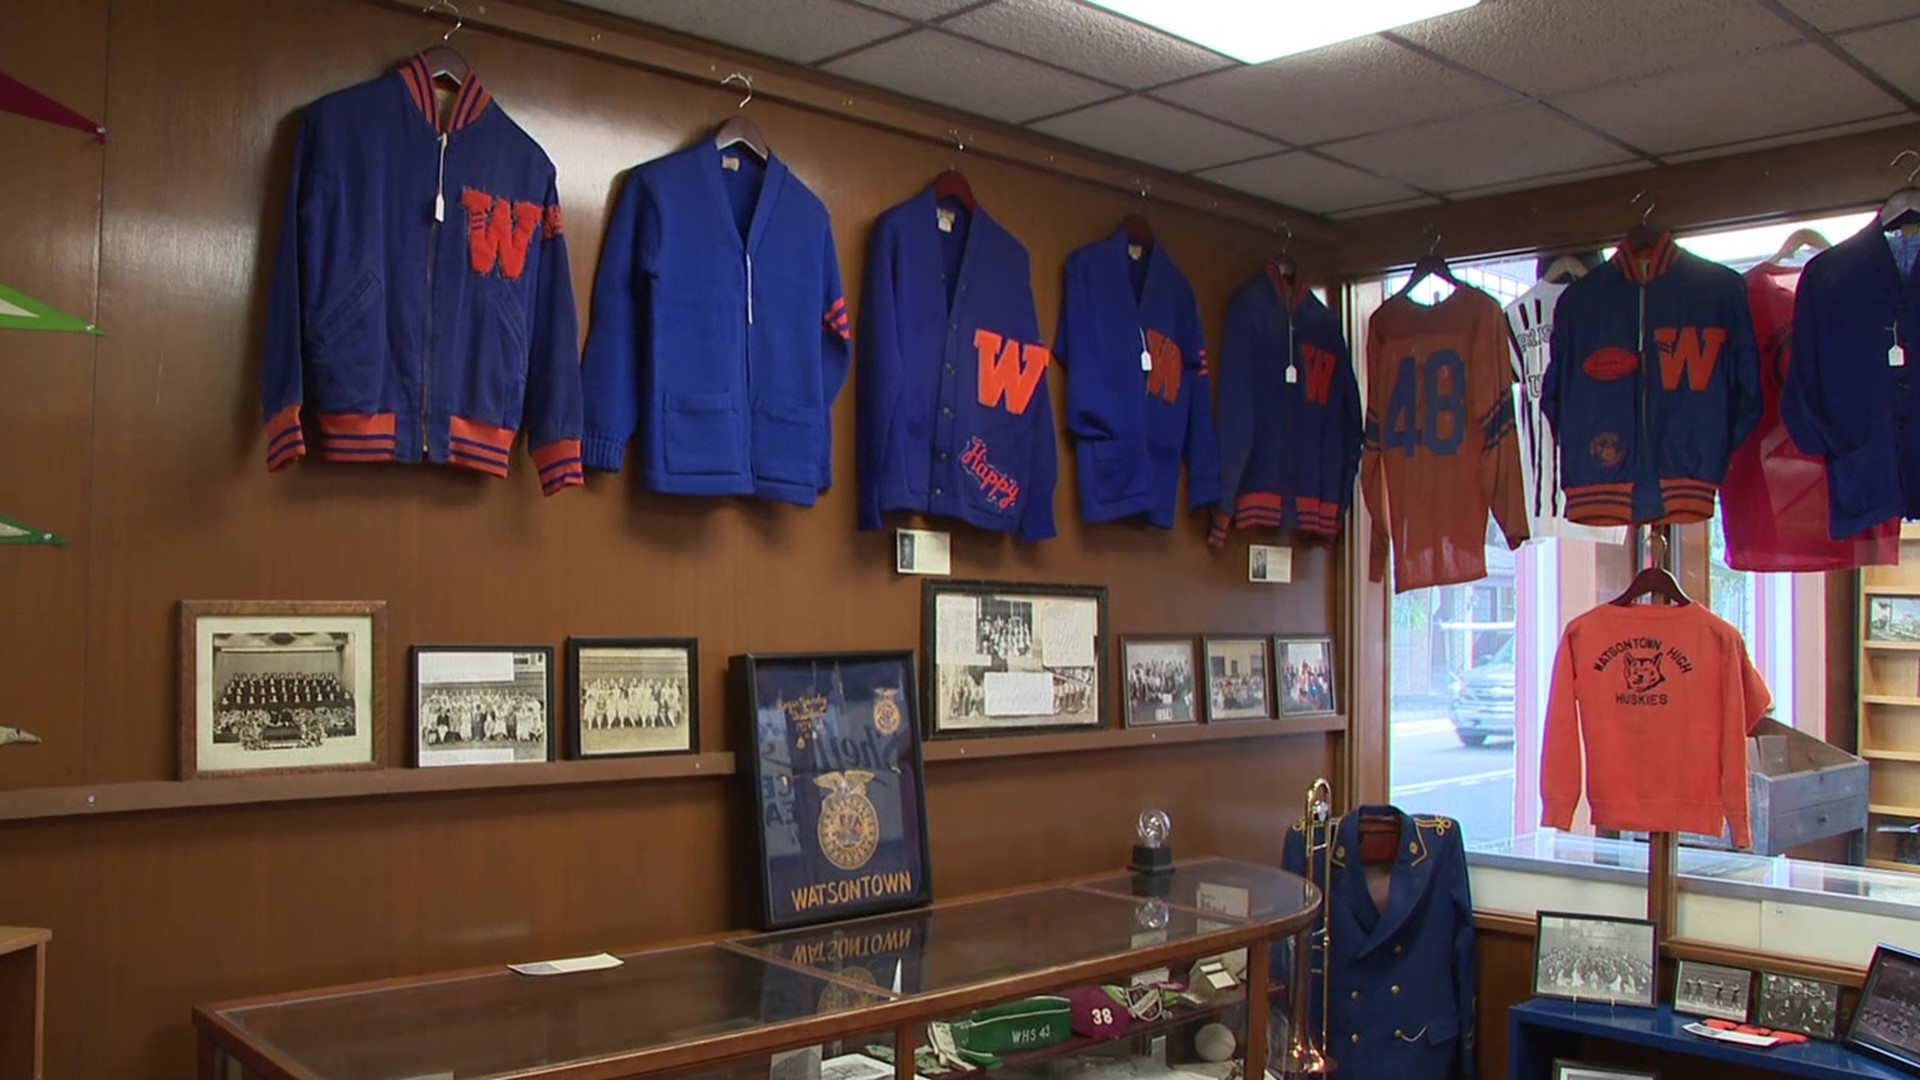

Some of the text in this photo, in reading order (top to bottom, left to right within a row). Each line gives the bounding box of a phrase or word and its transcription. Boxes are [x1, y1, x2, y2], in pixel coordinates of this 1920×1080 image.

[462, 187, 542, 280] W
[973, 327, 1050, 415] W
[1146, 326, 1182, 405] W
[1302, 343, 1337, 407] W
[1654, 326, 1728, 392] W
[1384, 349, 1466, 457] 48
[961, 435, 1020, 510] Happy
[1593, 637, 1693, 674] WATSONTOWN HIGH
[1615, 693, 1668, 706] HUSKIES
[791, 871, 912, 911] WATSONTOWN
[1011, 1028, 1037, 1044] WHS
[1091, 1007, 1114, 1025] 38
